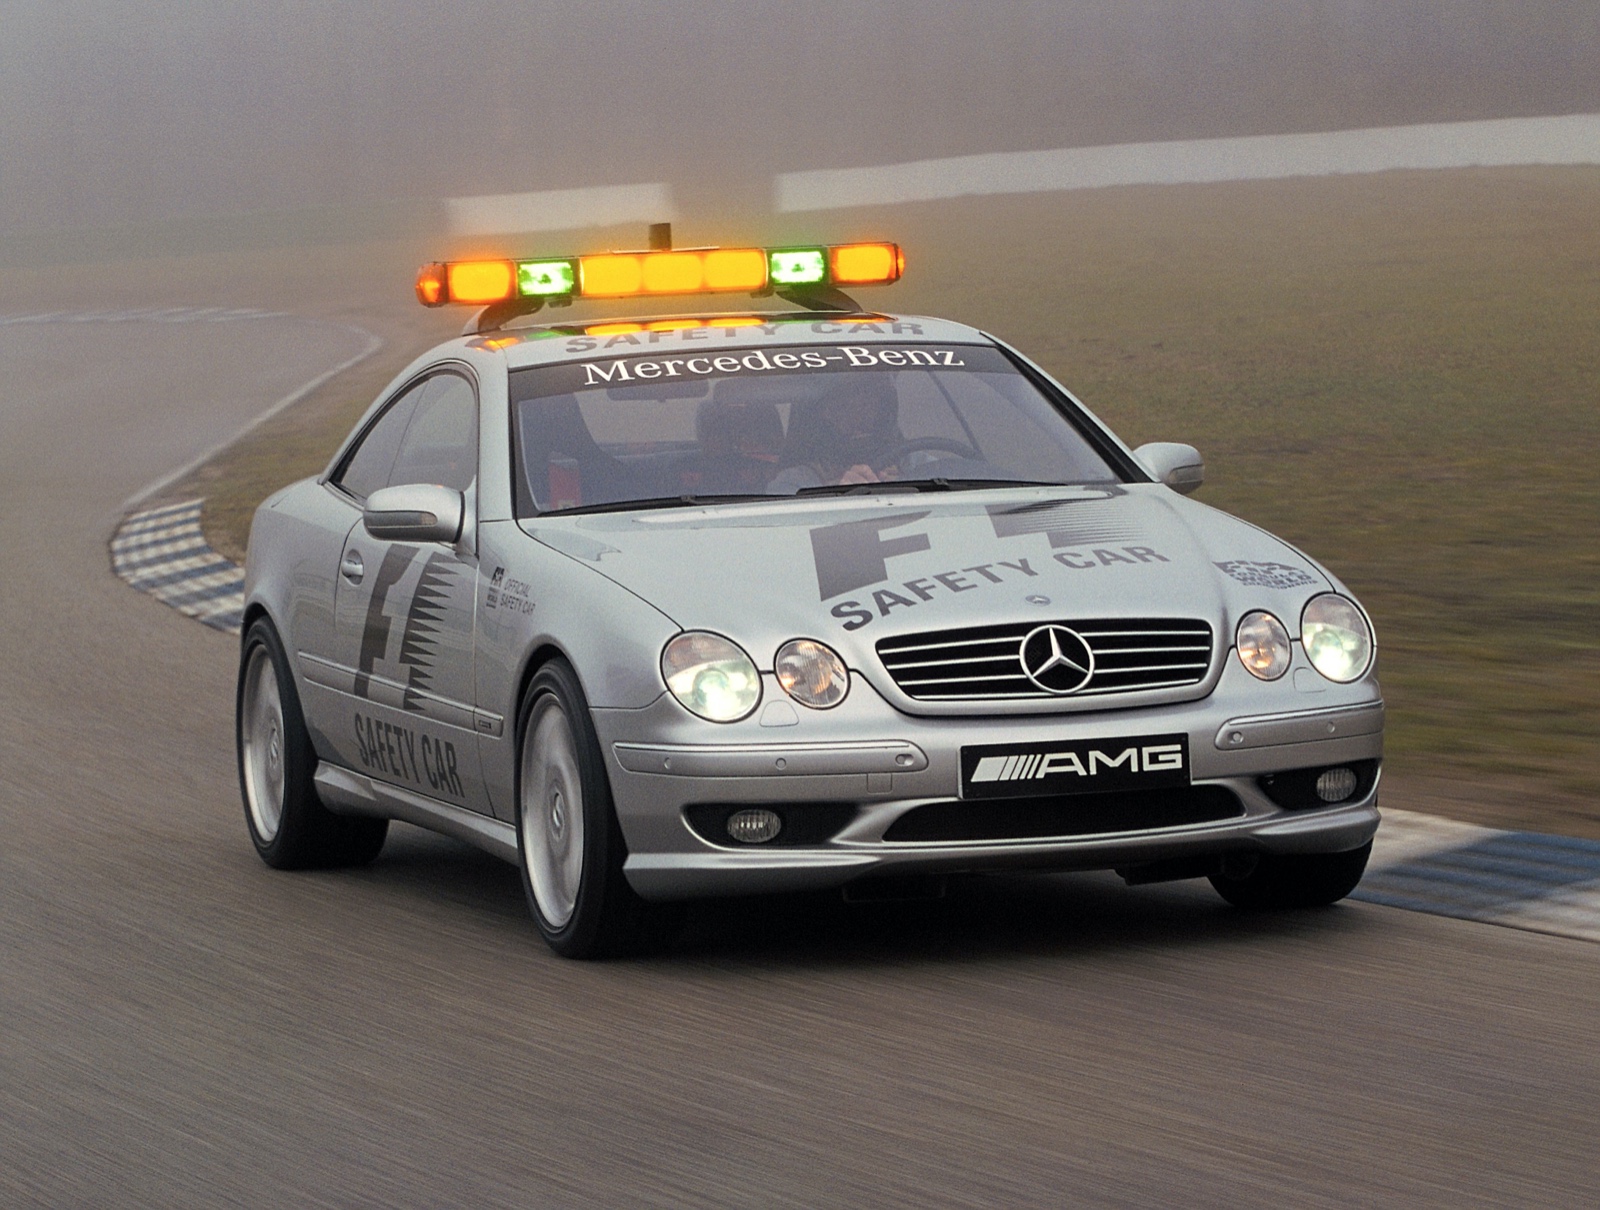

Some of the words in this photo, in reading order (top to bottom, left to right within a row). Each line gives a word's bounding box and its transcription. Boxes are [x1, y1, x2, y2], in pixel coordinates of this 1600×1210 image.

[565, 322, 781, 353] SAFETY
[811, 322, 924, 335] CAR
[582, 346, 965, 385] Mercedes-Benz
[830, 558, 1039, 631] SAFETY
[1052, 546, 1171, 569] CAR
[354, 713, 420, 784] SAFETY
[421, 734, 465, 798] CAR
[1035, 744, 1183, 780] AMG
